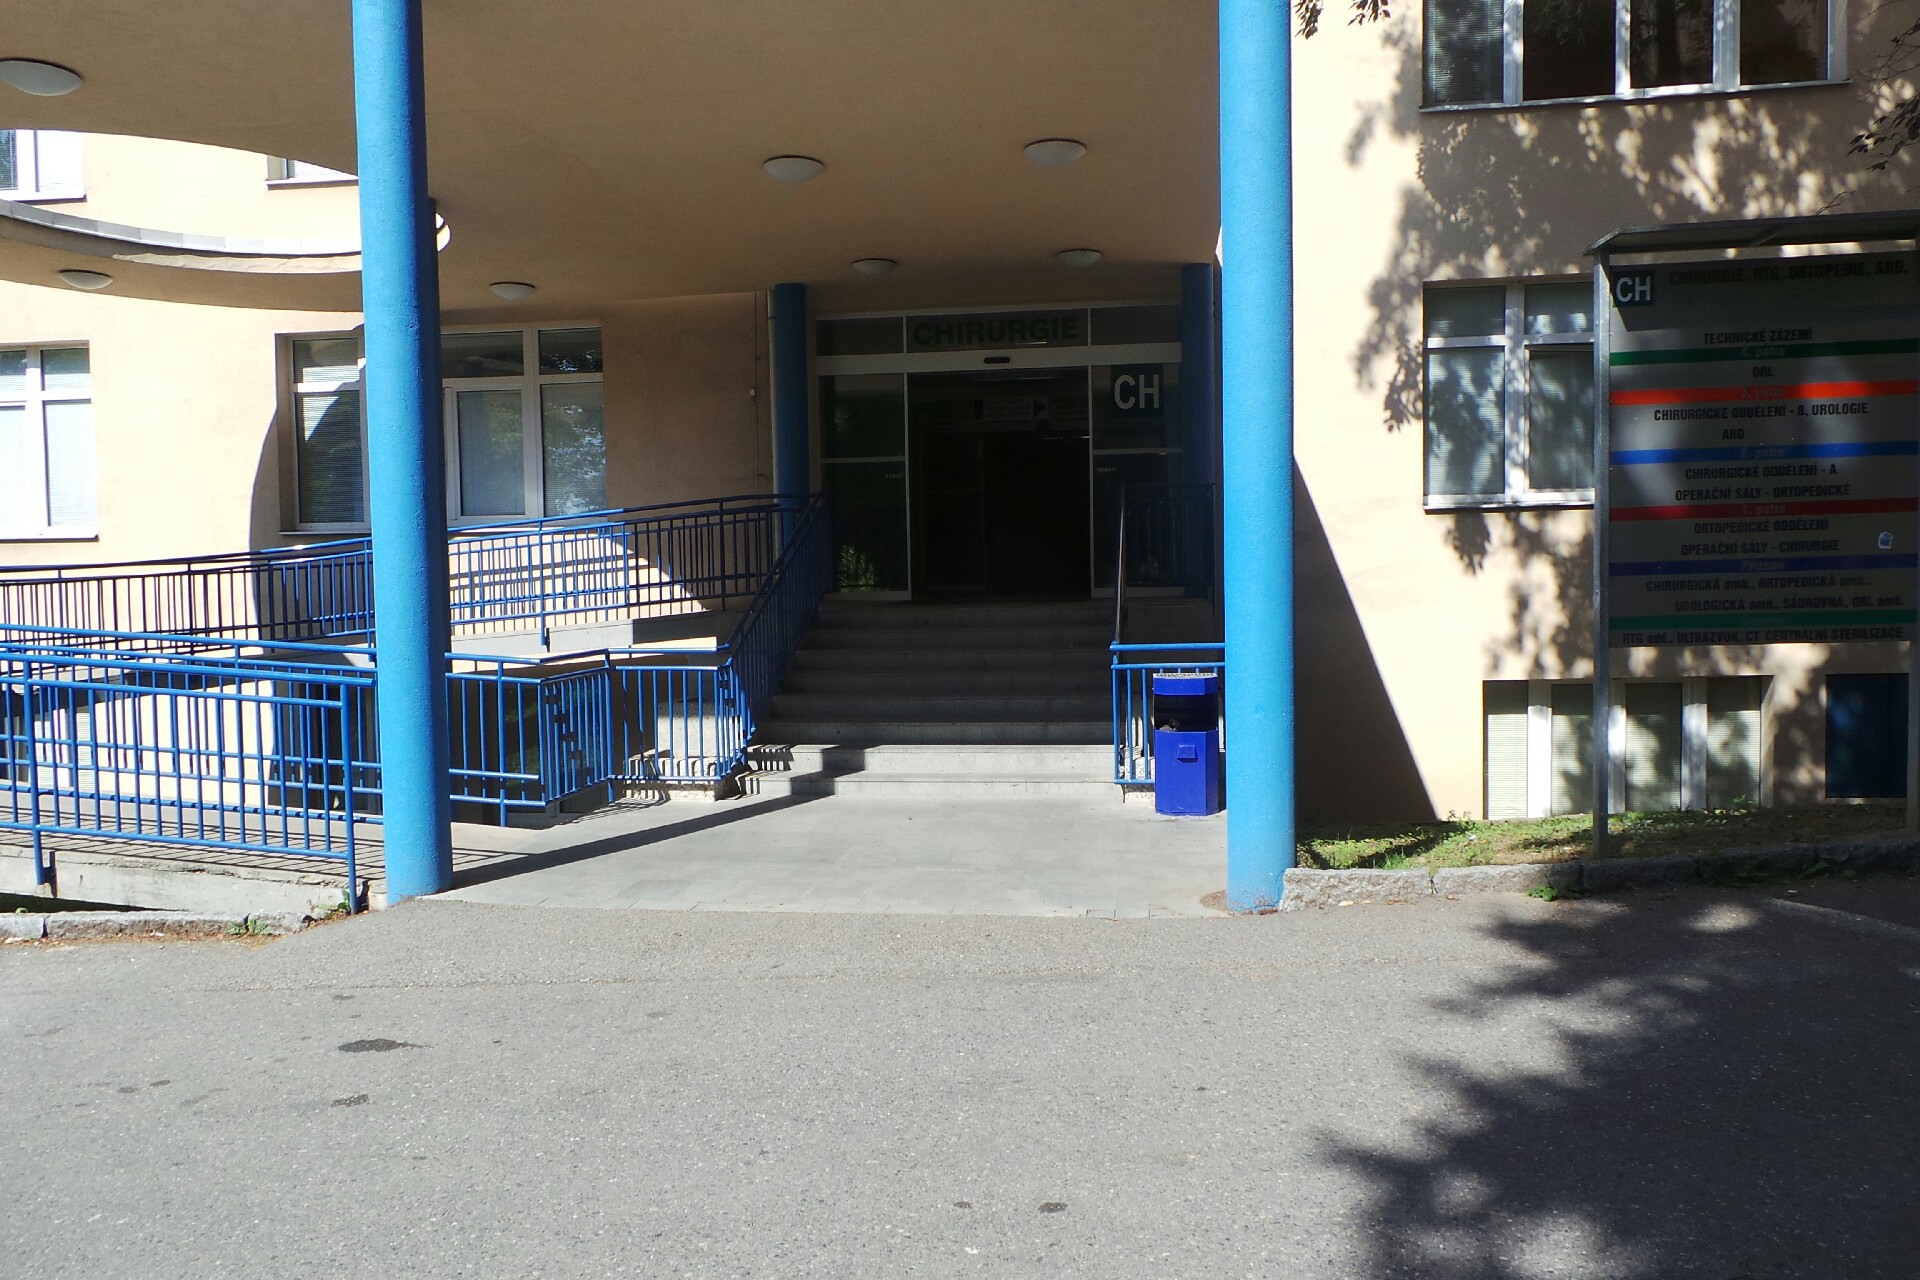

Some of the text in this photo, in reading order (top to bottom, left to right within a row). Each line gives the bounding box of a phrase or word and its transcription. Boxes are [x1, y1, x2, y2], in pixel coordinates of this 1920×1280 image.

[1615, 276, 1651, 302] CH
[913, 317, 1080, 345] CHIRURGIE
[1704, 326, 1812, 344] TECHNICKÉ ZÁZEMÍ
[1752, 366, 1774, 378] ORL
[1114, 374, 1160, 410] CH
[1654, 406, 1728, 421] CHIRURGICKÉ
[1732, 403, 1786, 419] ODDĚLENÍ
[1812, 402, 1868, 416] UROLOGIE
[1722, 428, 1745, 441] ARO
[1685, 465, 1759, 480] CHIRURGICKÉ
[1763, 462, 1817, 477] ODDĚLENÍ
[1829, 464, 1837, 475] A
[1675, 485, 1731, 501] OPERAČNÍ
[1735, 484, 1761, 499] SÁLY
[1773, 484, 1851, 498] ORTOPEDICKÉ
[1742, 504, 1786, 517] 1. patro
[1694, 520, 1770, 534] ORTOPEDICKÉ
[1681, 541, 1738, 556] OPERAČNÍ
[1741, 539, 1768, 554] SÁLY
[1779, 539, 1840, 553] CHIRURGIE
[1646, 577, 1720, 592] CHIRURGICKÁ
[1724, 578, 1755, 590] amb.,
[1758, 574, 1836, 589] ORTOPEDICKÁ
[1675, 597, 1745, 612] UROLOGICKÁ
[1852, 596, 1873, 607] ORL
[1877, 595, 1905, 607] amb.
[1622, 632, 1643, 643] RTG
[1745, 630, 1760, 642] CT
[1831, 627, 1903, 640] STERILIZACE
